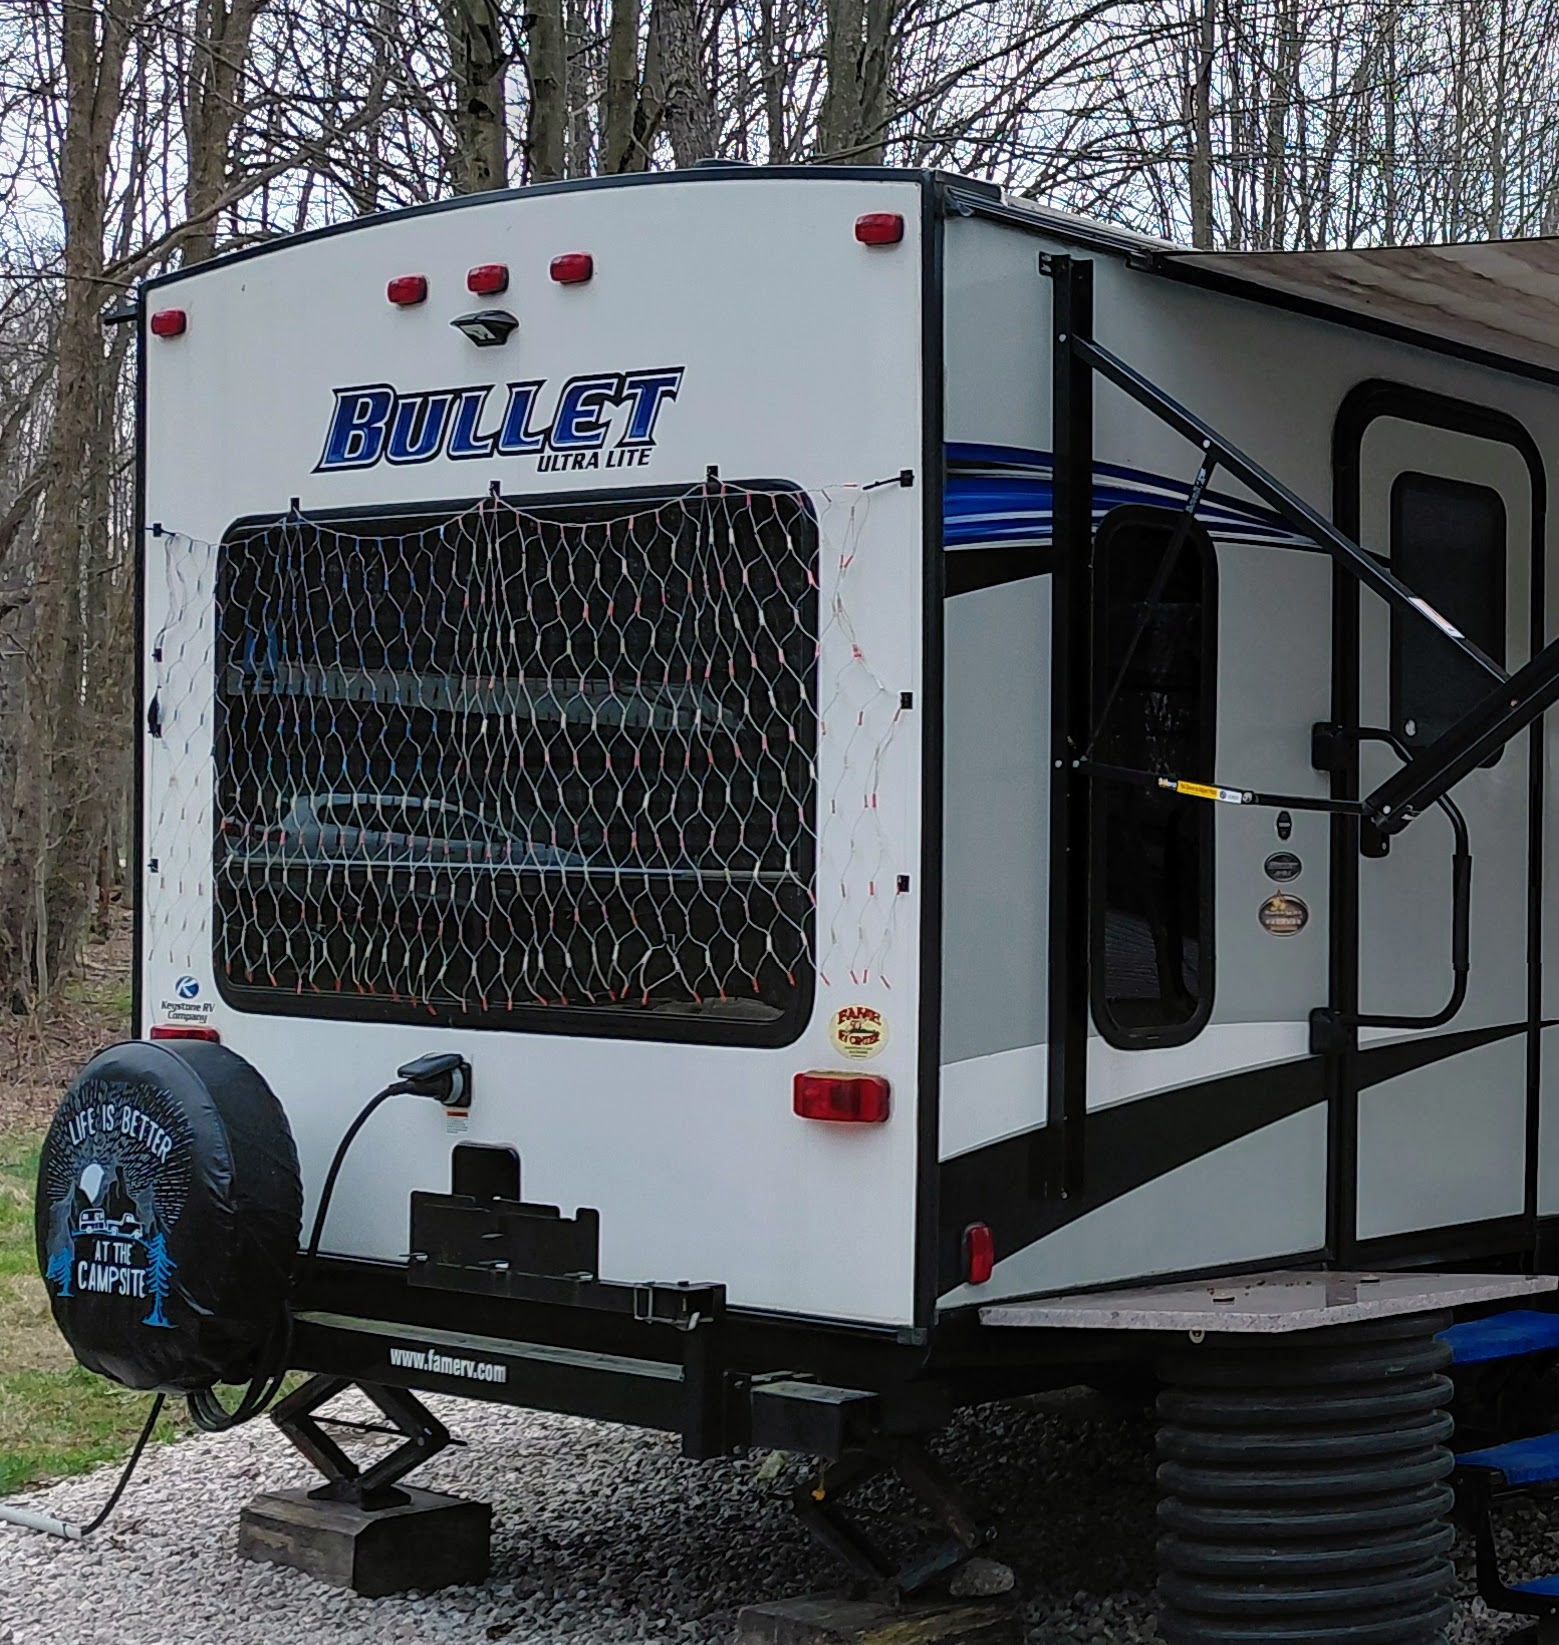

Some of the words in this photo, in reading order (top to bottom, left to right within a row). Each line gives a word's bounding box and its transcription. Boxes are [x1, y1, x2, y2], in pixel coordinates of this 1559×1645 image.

[310, 366, 686, 474] BULLET
[536, 452, 599, 473] ULTRA
[604, 448, 651, 468] LITE
[161, 1001, 202, 1012] Keystone
[202, 1003, 216, 1012] RV
[168, 1010, 208, 1024] Company
[69, 1107, 96, 1146] LIFE
[102, 1104, 115, 1131] IS
[121, 1105, 173, 1164] BETTER
[94, 1240, 110, 1262] AT
[112, 1242, 134, 1265] THE
[77, 1260, 148, 1299] CAMPSITE
[390, 1348, 507, 1383] www.famerv.com
